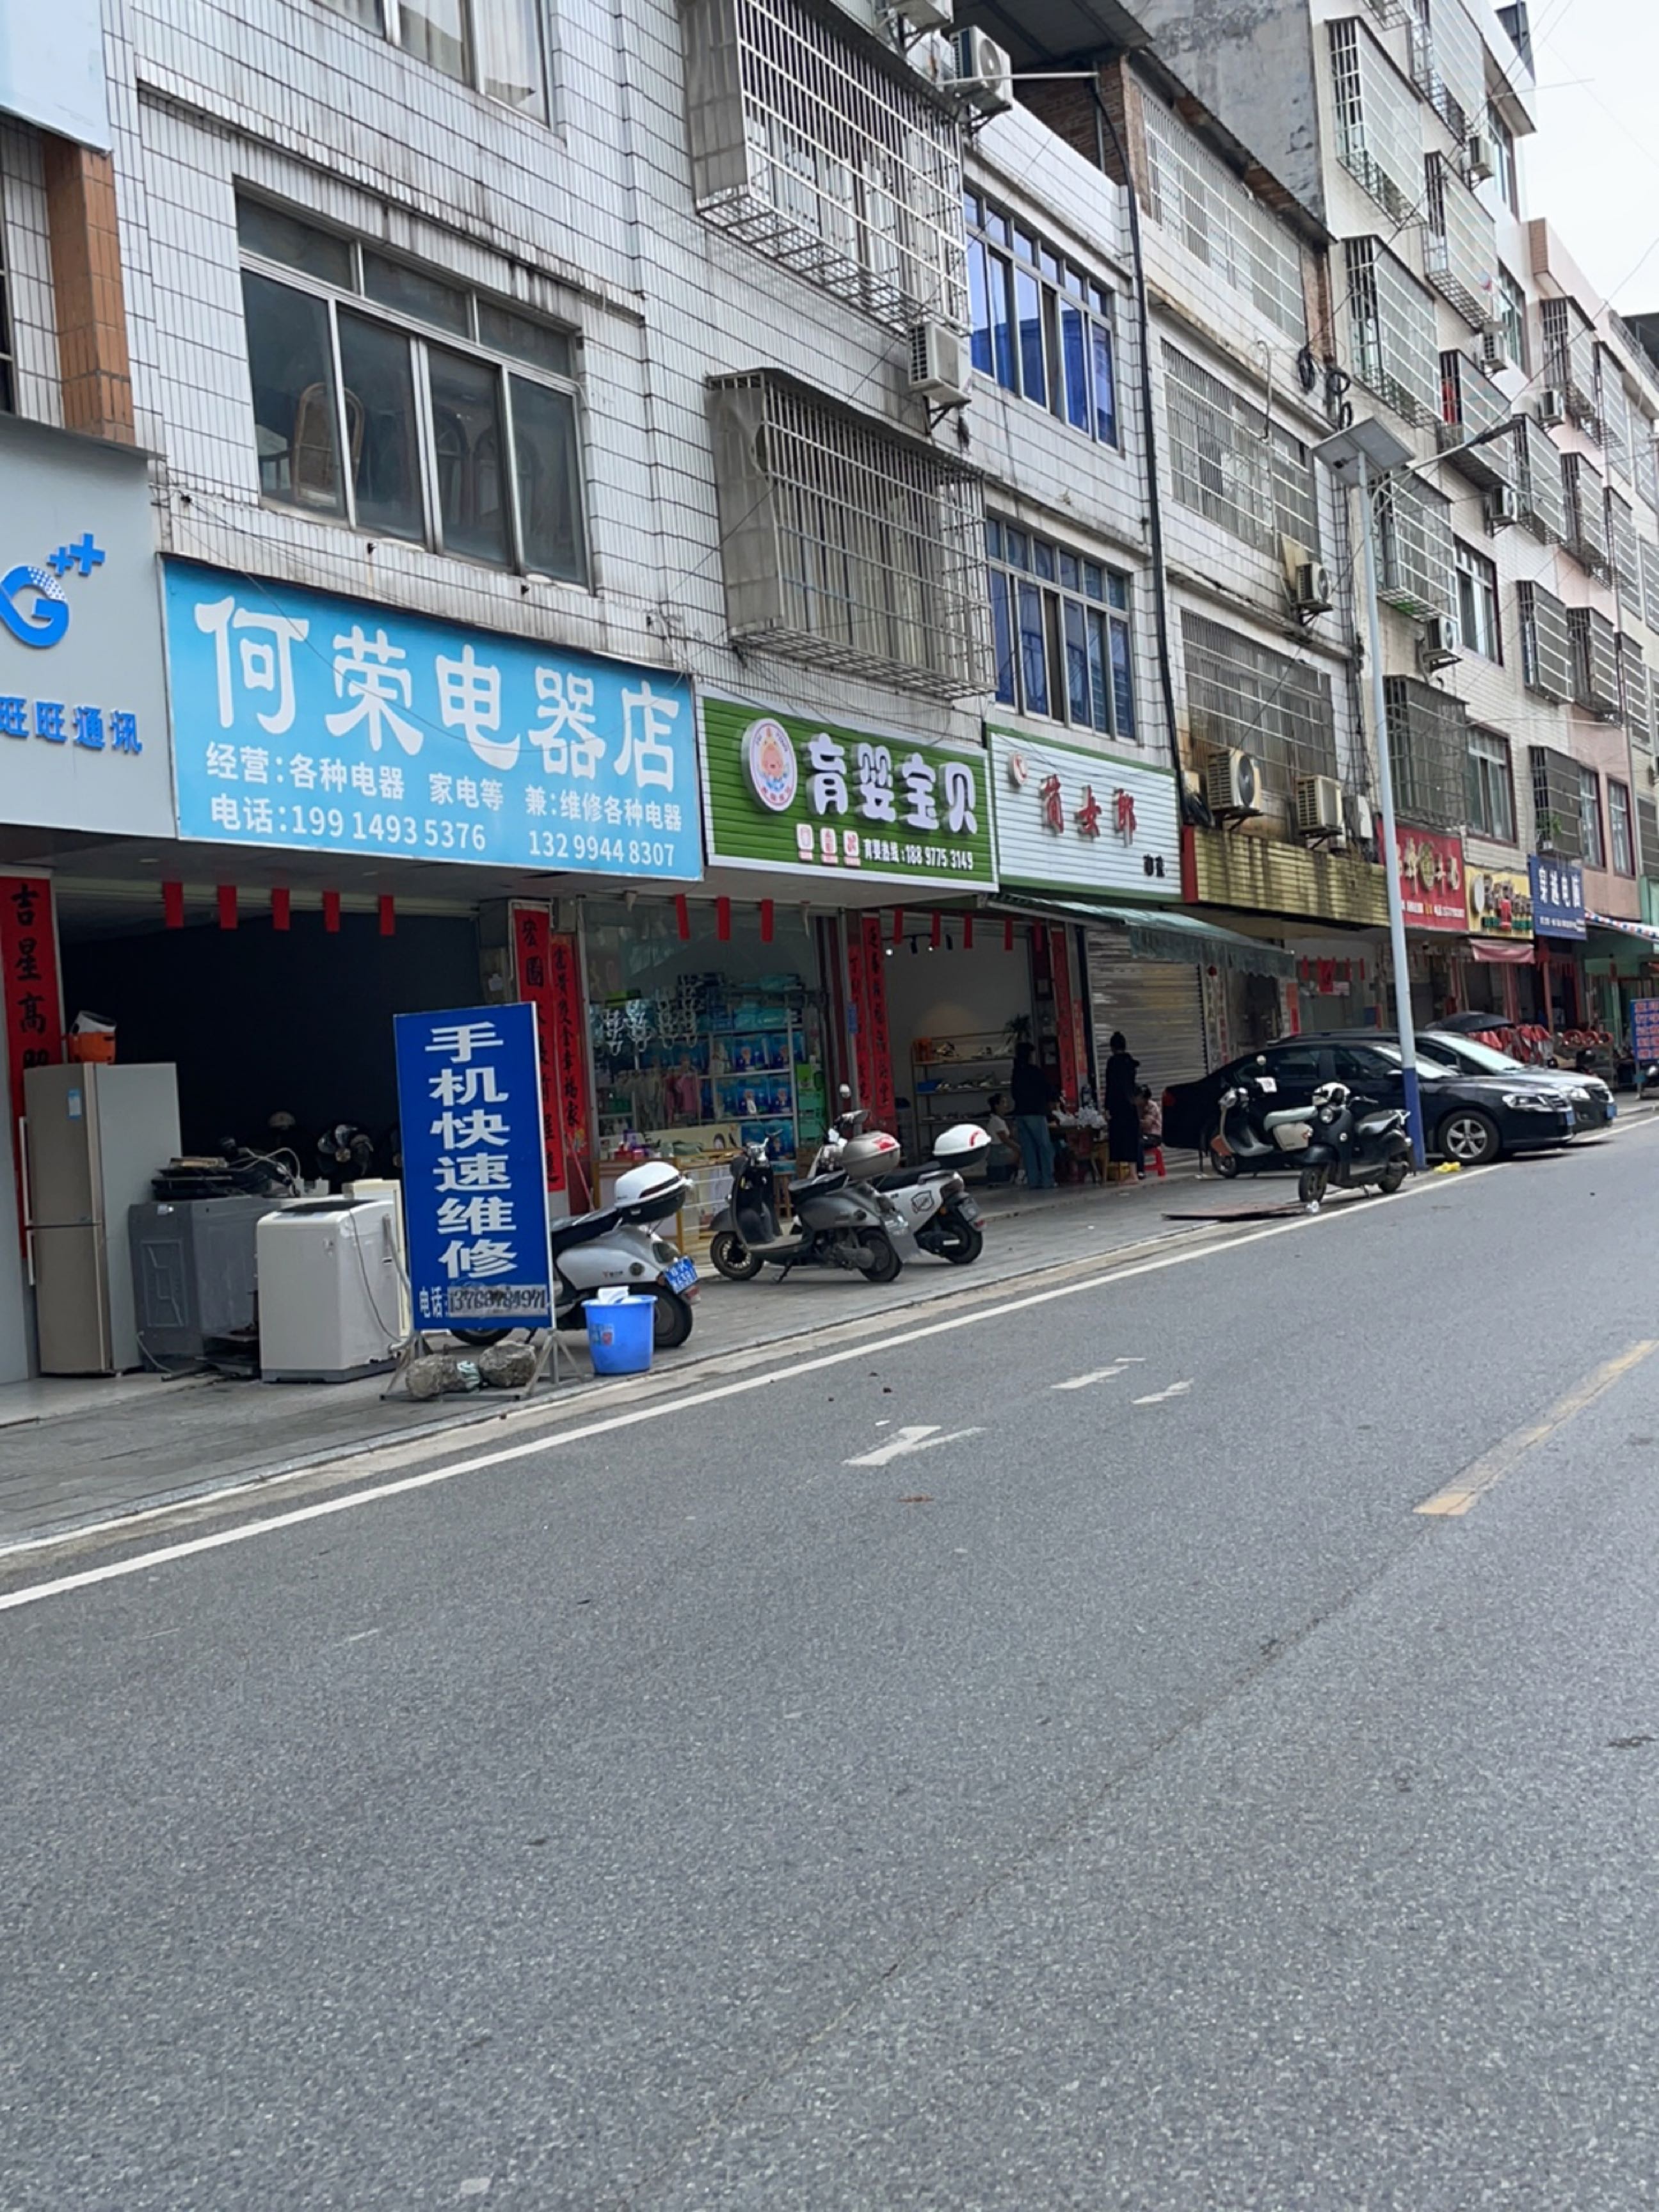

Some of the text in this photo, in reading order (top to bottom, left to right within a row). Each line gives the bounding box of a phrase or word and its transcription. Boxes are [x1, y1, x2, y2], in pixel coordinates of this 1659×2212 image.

[0, 696, 142, 755] 旺旺通讯
[194, 596, 679, 792] 何荣电器店
[429, 772, 504, 812] 家电等
[805, 732, 977, 835] 育婴宝贝
[425, 1020, 518, 1279] 手机快速维修
